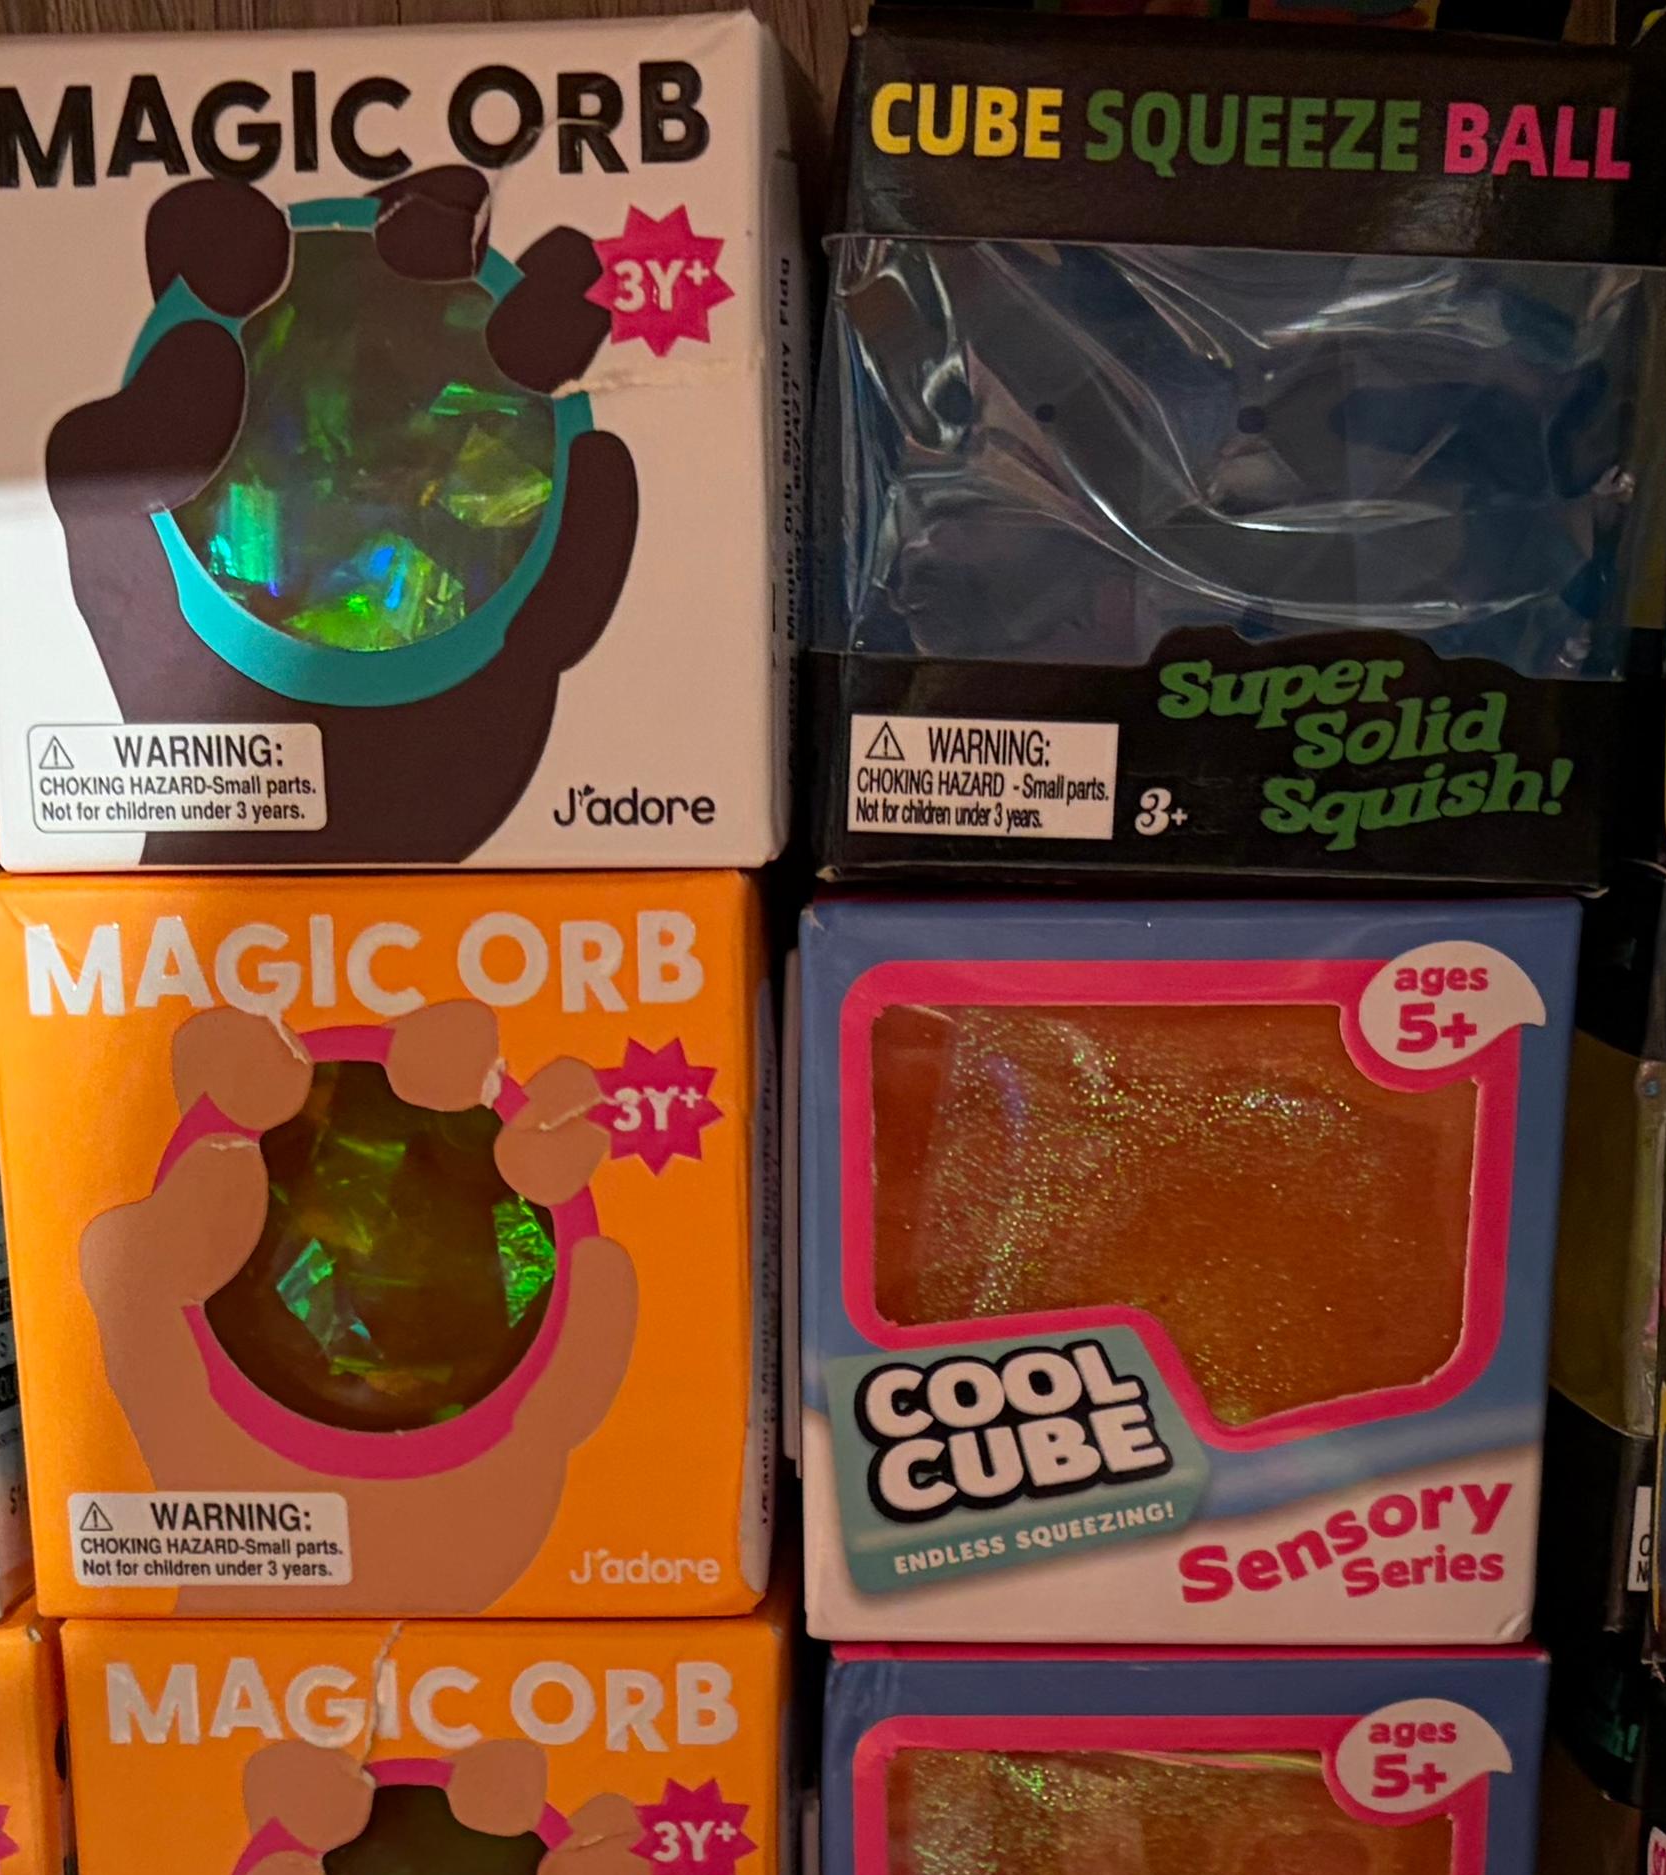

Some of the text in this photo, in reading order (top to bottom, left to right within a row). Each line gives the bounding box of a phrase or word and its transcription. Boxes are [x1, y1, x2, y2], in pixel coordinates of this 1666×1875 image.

[448, 60, 709, 176] ORB
[871, 82, 1631, 180] CUBE SQUEEZE BALL
[1158, 659, 1404, 729] Super
[114, 734, 283, 768] WARNING:
[929, 726, 1051, 767] WARNING:
[1294, 693, 1508, 772] Solid
[40, 776, 316, 798] CHOKING HAZARD-Small parts.
[554, 784, 715, 826] J'adore
[1260, 759, 1574, 851] Squish!
[42, 801, 304, 824] Not for children under 3 years.
[1136, 788, 1188, 837] 3+
[24, 910, 704, 1017] MAGIC ORB
[1395, 963, 1487, 995] ages
[1396, 1004, 1477, 1052] 5+
[865, 1341, 1138, 1439] COOL
[877, 1411, 1165, 1512] CUBE
[895, 1500, 1174, 1575] ENDLESS SQUEEZING!
[1178, 1481, 1513, 1603] Sensory
[569, 1546, 719, 1585] J'adore
[1345, 1548, 1504, 1599] Series
[1369, 1720, 1457, 1748] ages
[1371, 1753, 1447, 1798] 5+
